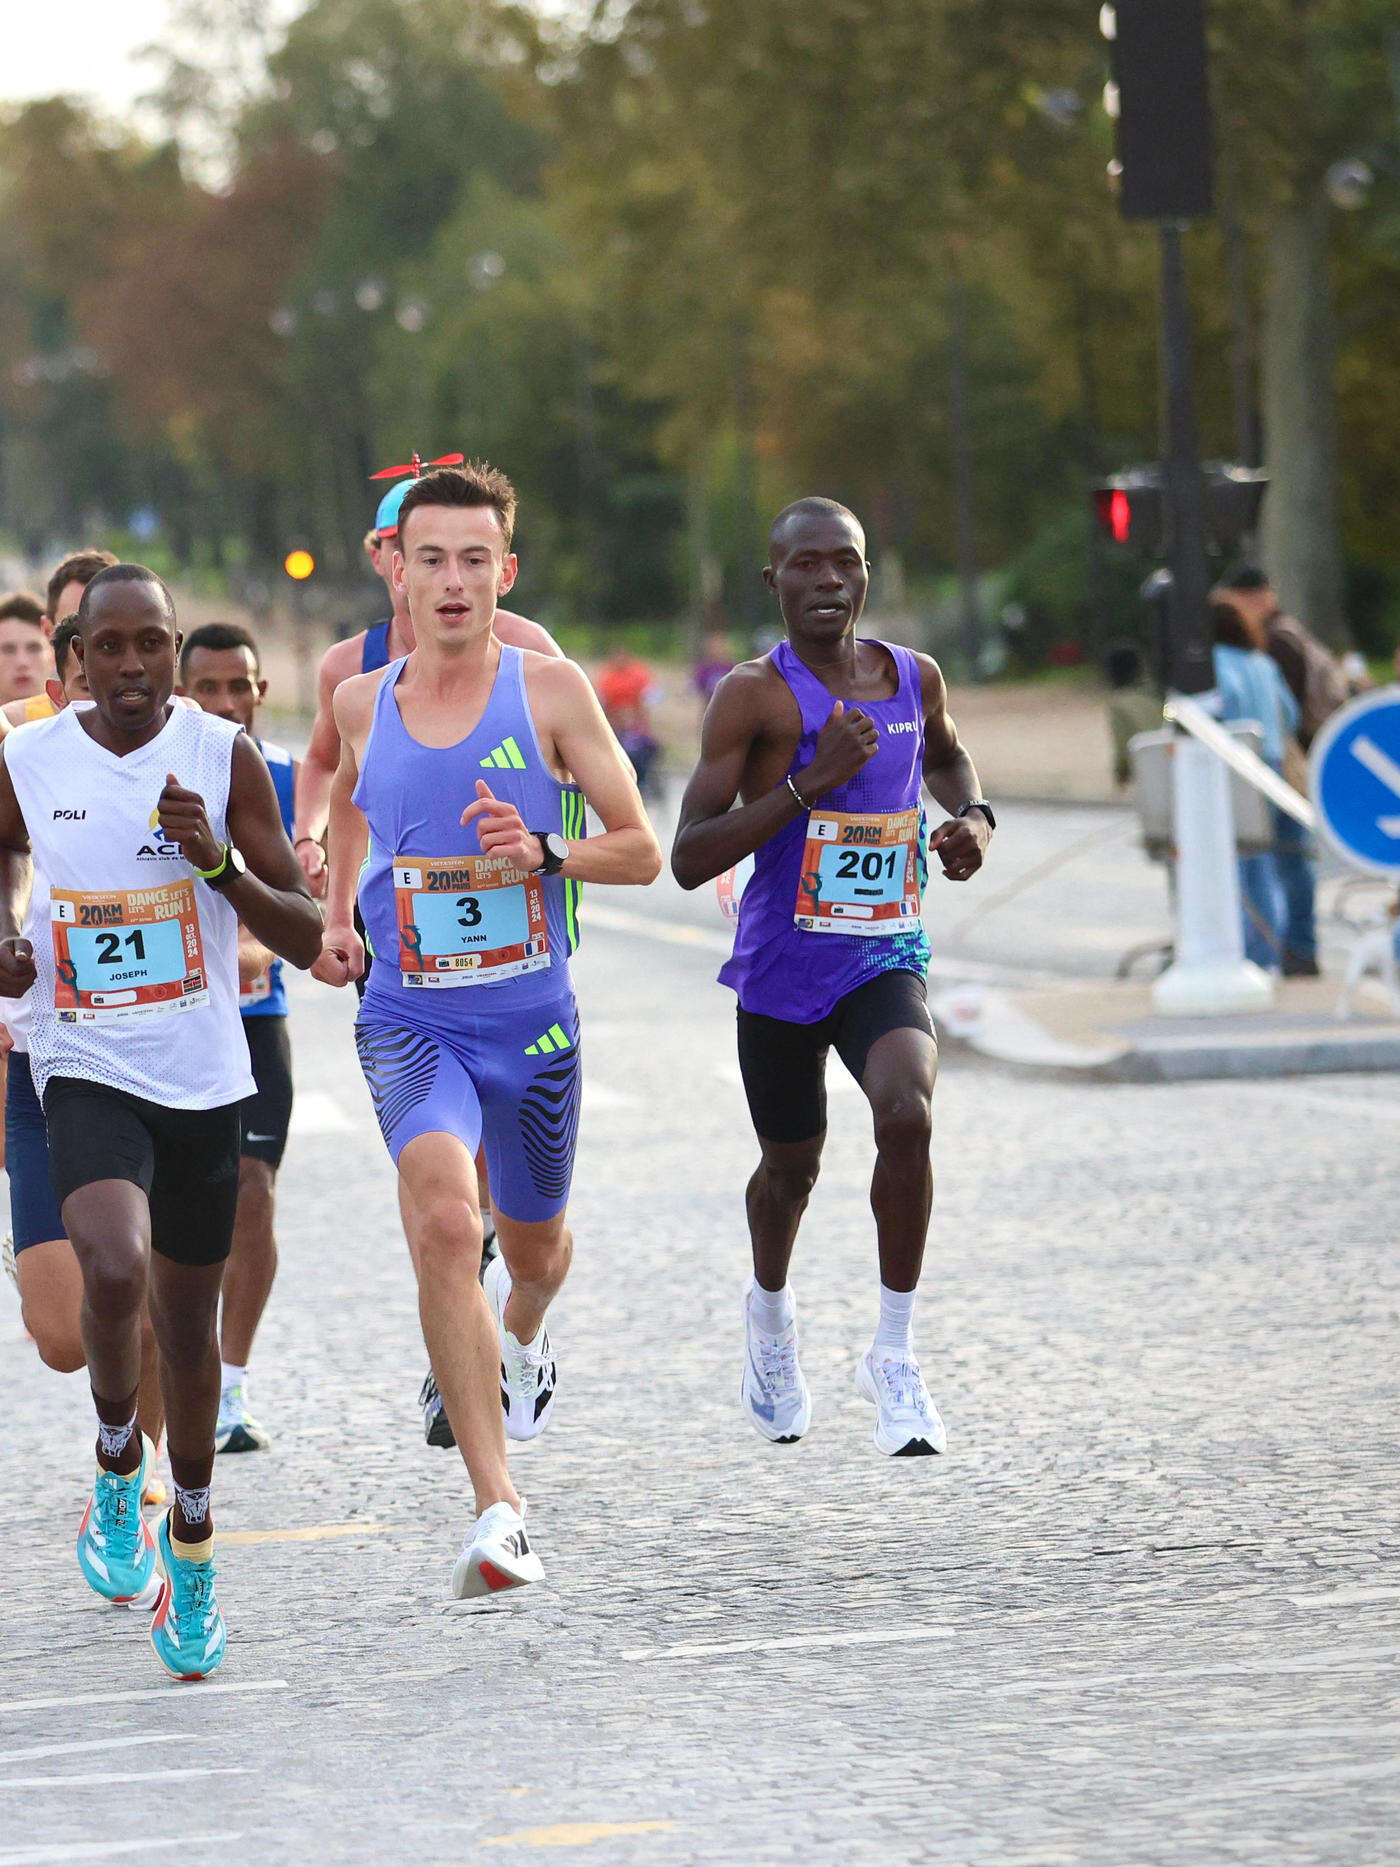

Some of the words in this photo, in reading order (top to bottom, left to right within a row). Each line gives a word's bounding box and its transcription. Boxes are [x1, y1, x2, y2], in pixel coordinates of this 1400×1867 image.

[53, 810, 86, 820] POLI
[818, 824, 826, 836] E
[842, 825, 864, 844] 20
[864, 826, 882, 838] KM
[835, 850, 897, 880] 201
[404, 872, 411, 884] E
[426, 871, 450, 890] 20
[451, 870, 470, 882] KM
[126, 889, 169, 906] DANCE
[171, 888, 189, 900] LET'S
[530, 890, 538, 898] 13
[59, 905, 65, 918] E
[79, 904, 103, 925] 20
[103, 904, 122, 916] KM
[128, 906, 144, 914] LET'S
[154, 902, 184, 920] RUN
[456, 897, 482, 927] 3
[531, 905, 540, 913] 20
[531, 912, 542, 923] 24
[186, 923, 194, 933] 13
[187, 940, 196, 948] 20
[461, 935, 487, 943] YANN
[95, 929, 146, 964] 21
[188, 948, 198, 958] 24
[455, 957, 473, 967] 8054
[109, 969, 148, 981] JOSEPH
